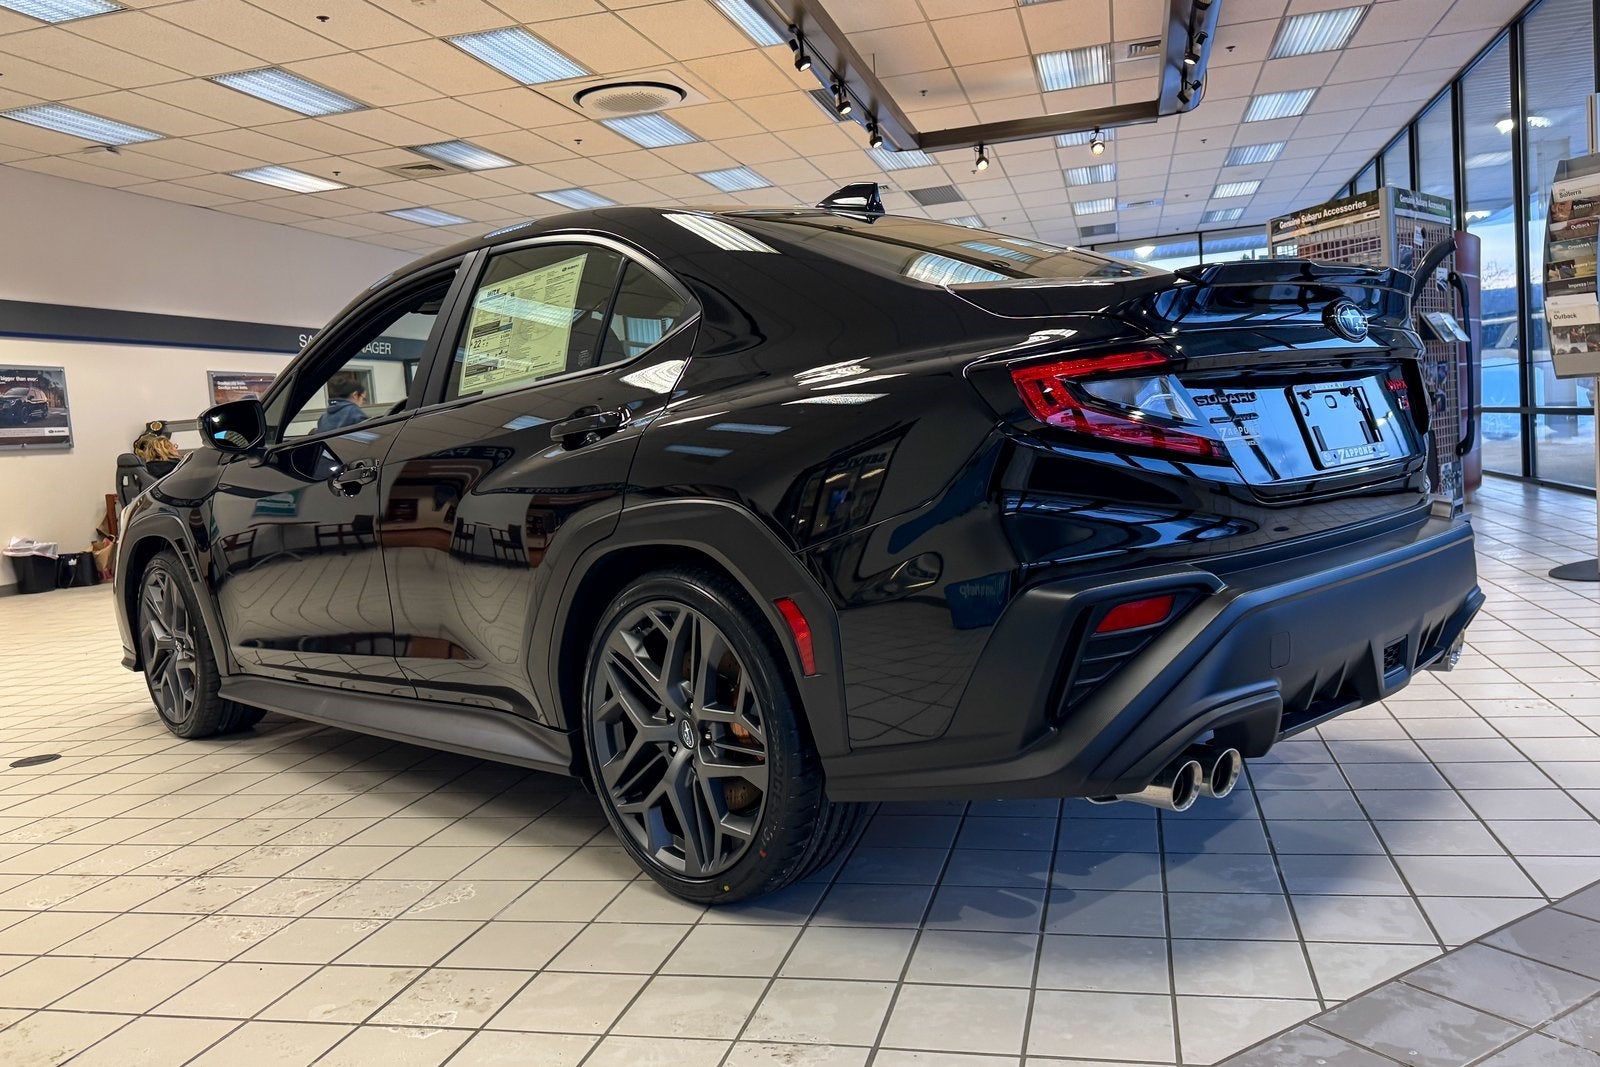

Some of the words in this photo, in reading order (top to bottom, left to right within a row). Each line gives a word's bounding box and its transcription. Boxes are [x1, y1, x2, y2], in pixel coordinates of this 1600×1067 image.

[1560, 190, 1582, 199] Solterra
[1280, 220, 1300, 229] Genuine
[1301, 213, 1322, 223] Subaru
[1323, 201, 1367, 217] Accessories
[1386, 380, 1407, 390] WRX
[1194, 392, 1257, 406] SUBARU
[1338, 445, 1374, 464] ZAPPONE
